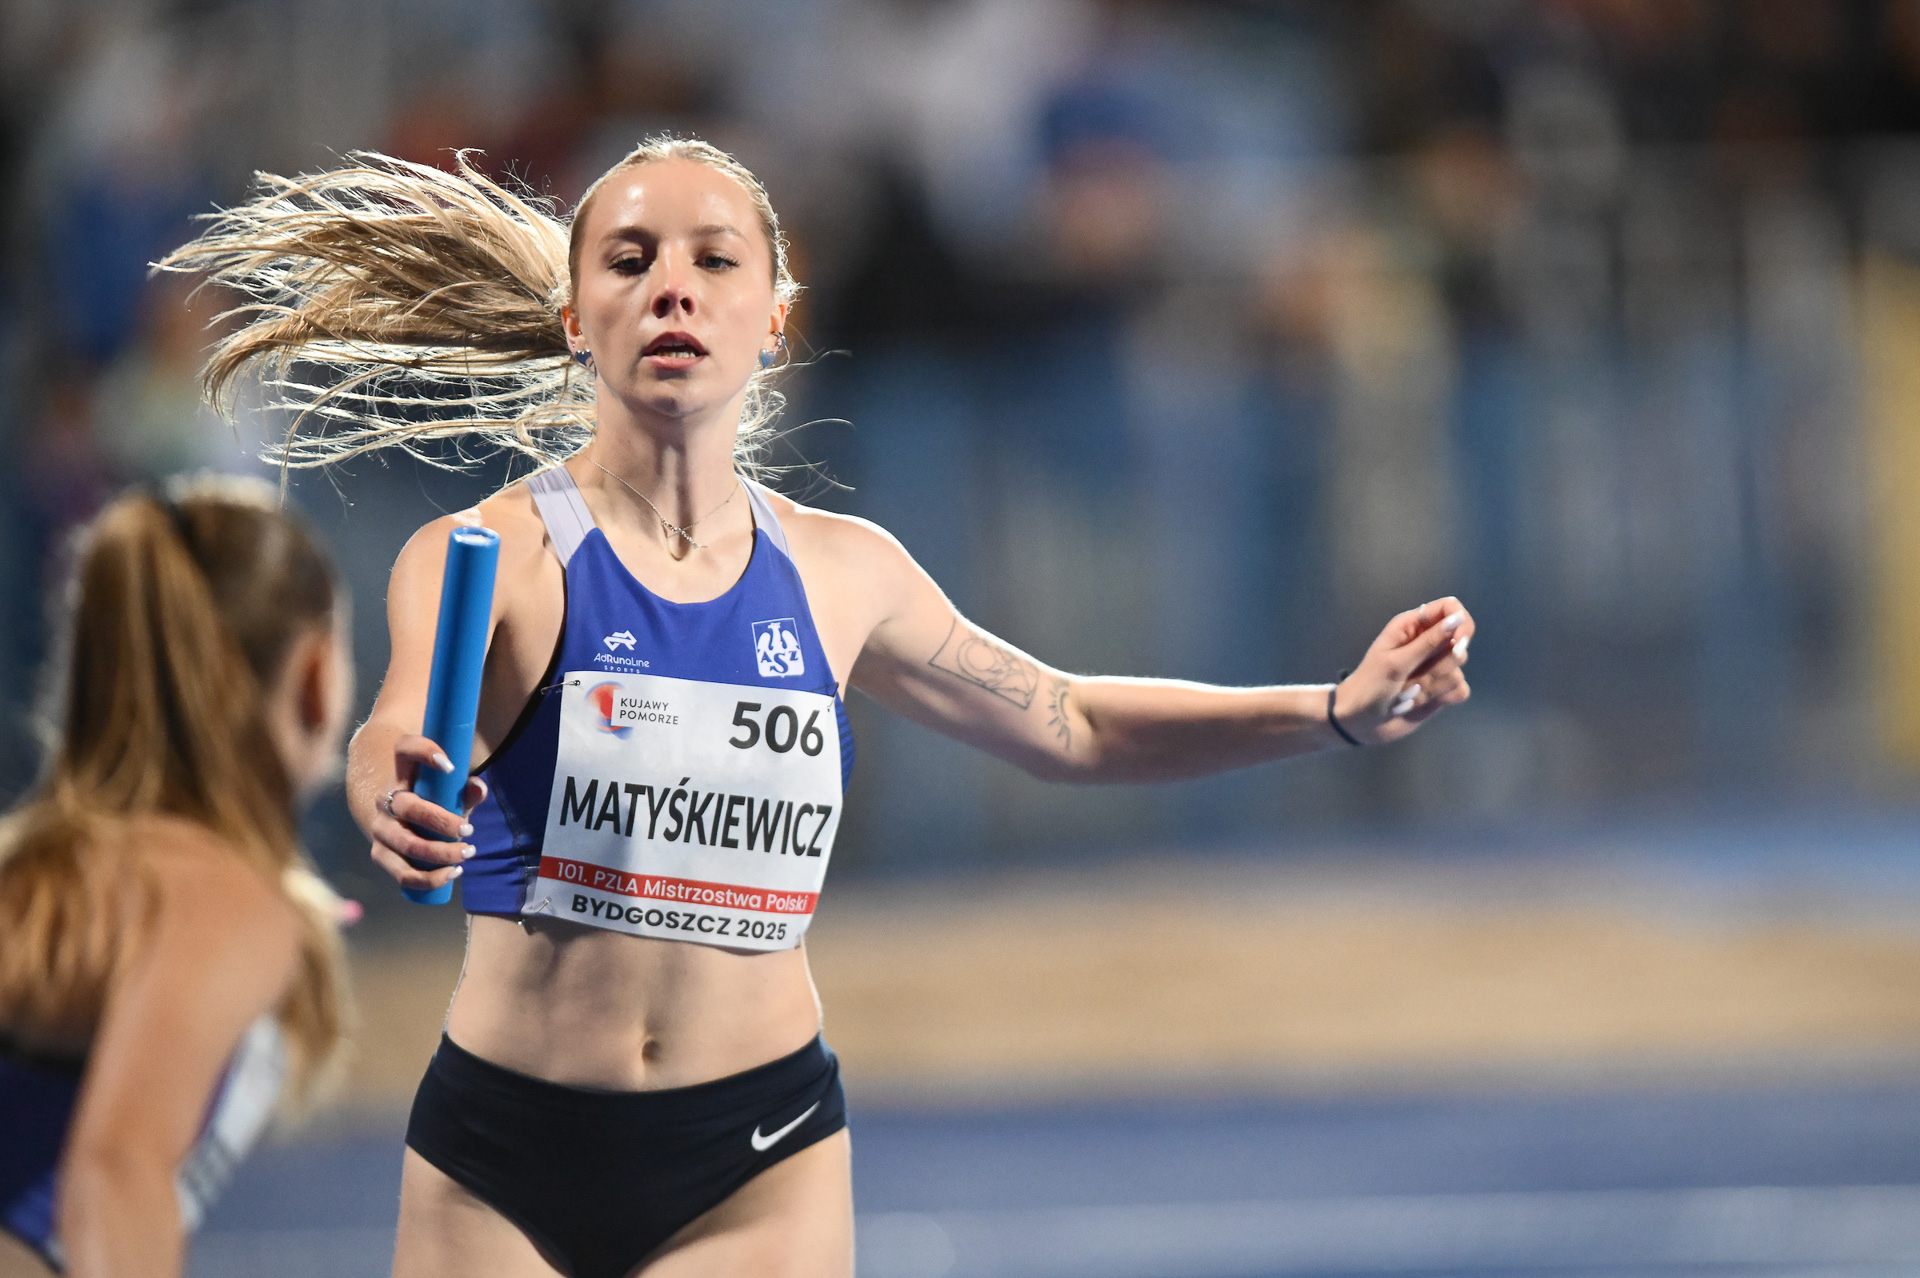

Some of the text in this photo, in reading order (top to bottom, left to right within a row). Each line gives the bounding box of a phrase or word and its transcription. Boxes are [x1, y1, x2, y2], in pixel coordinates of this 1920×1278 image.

[603, 664, 641, 674] SPORTS
[619, 709, 679, 726] POMORZE
[620, 697, 669, 712] KUJAWY
[728, 701, 824, 757] 506
[559, 776, 833, 857] MATYŚKIEWICZ
[557, 861, 808, 912] 101. PZLA Mistrzostwa Polski
[571, 893, 787, 940] BYDGOSZCZ 2025
